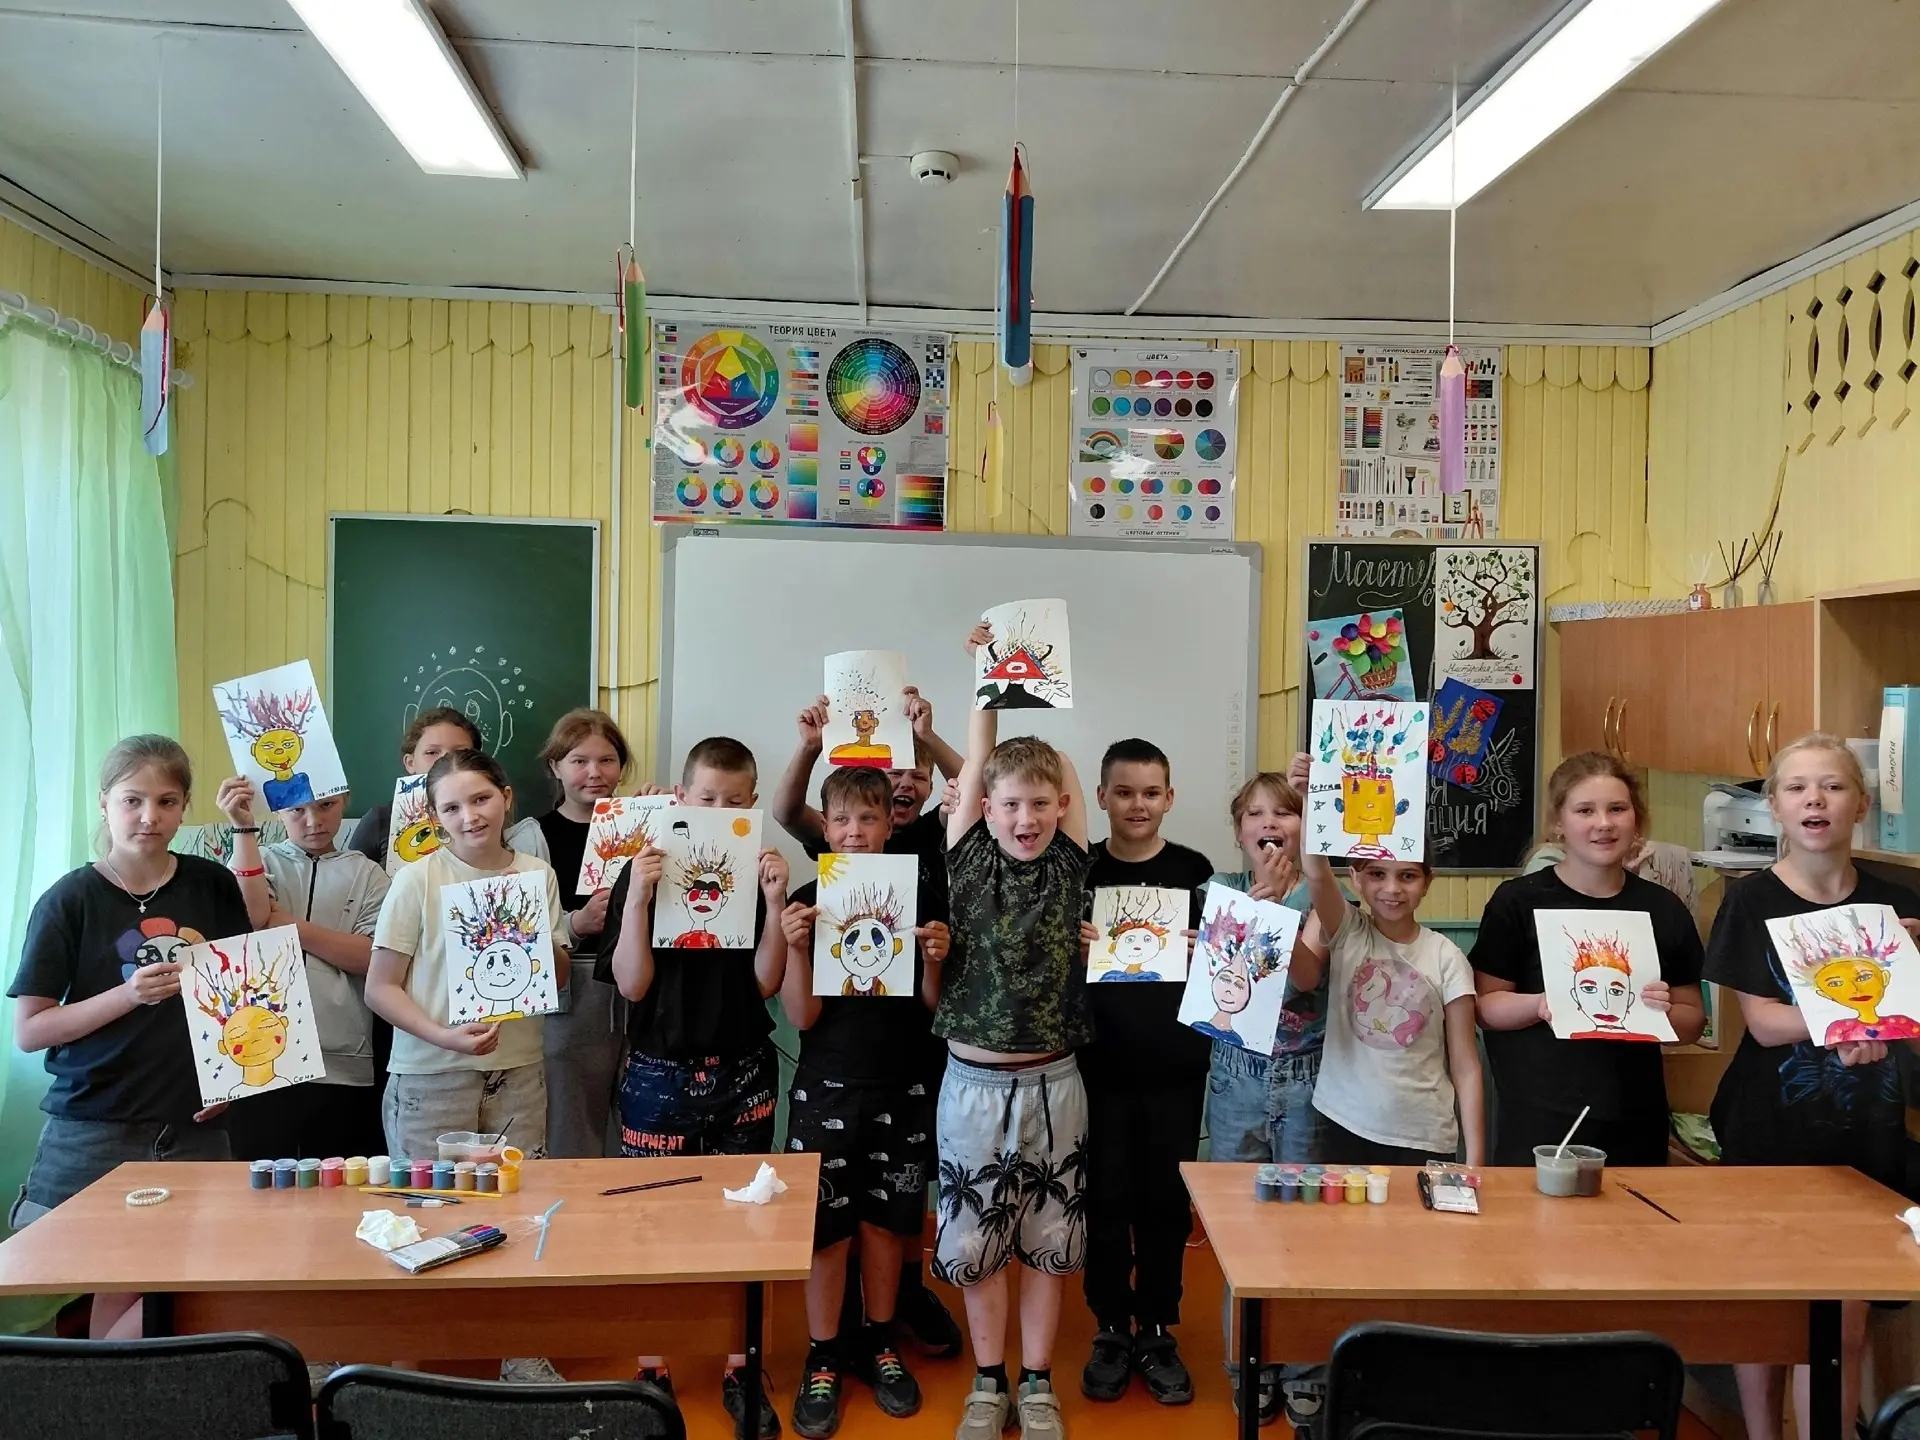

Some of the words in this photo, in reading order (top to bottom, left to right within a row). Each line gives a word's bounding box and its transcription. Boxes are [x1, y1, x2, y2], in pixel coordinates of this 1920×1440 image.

[768, 325, 804, 336] ТЕОРИЯ
[806, 327, 837, 338] ЦВЕТА
[859, 482, 864, 490] C
